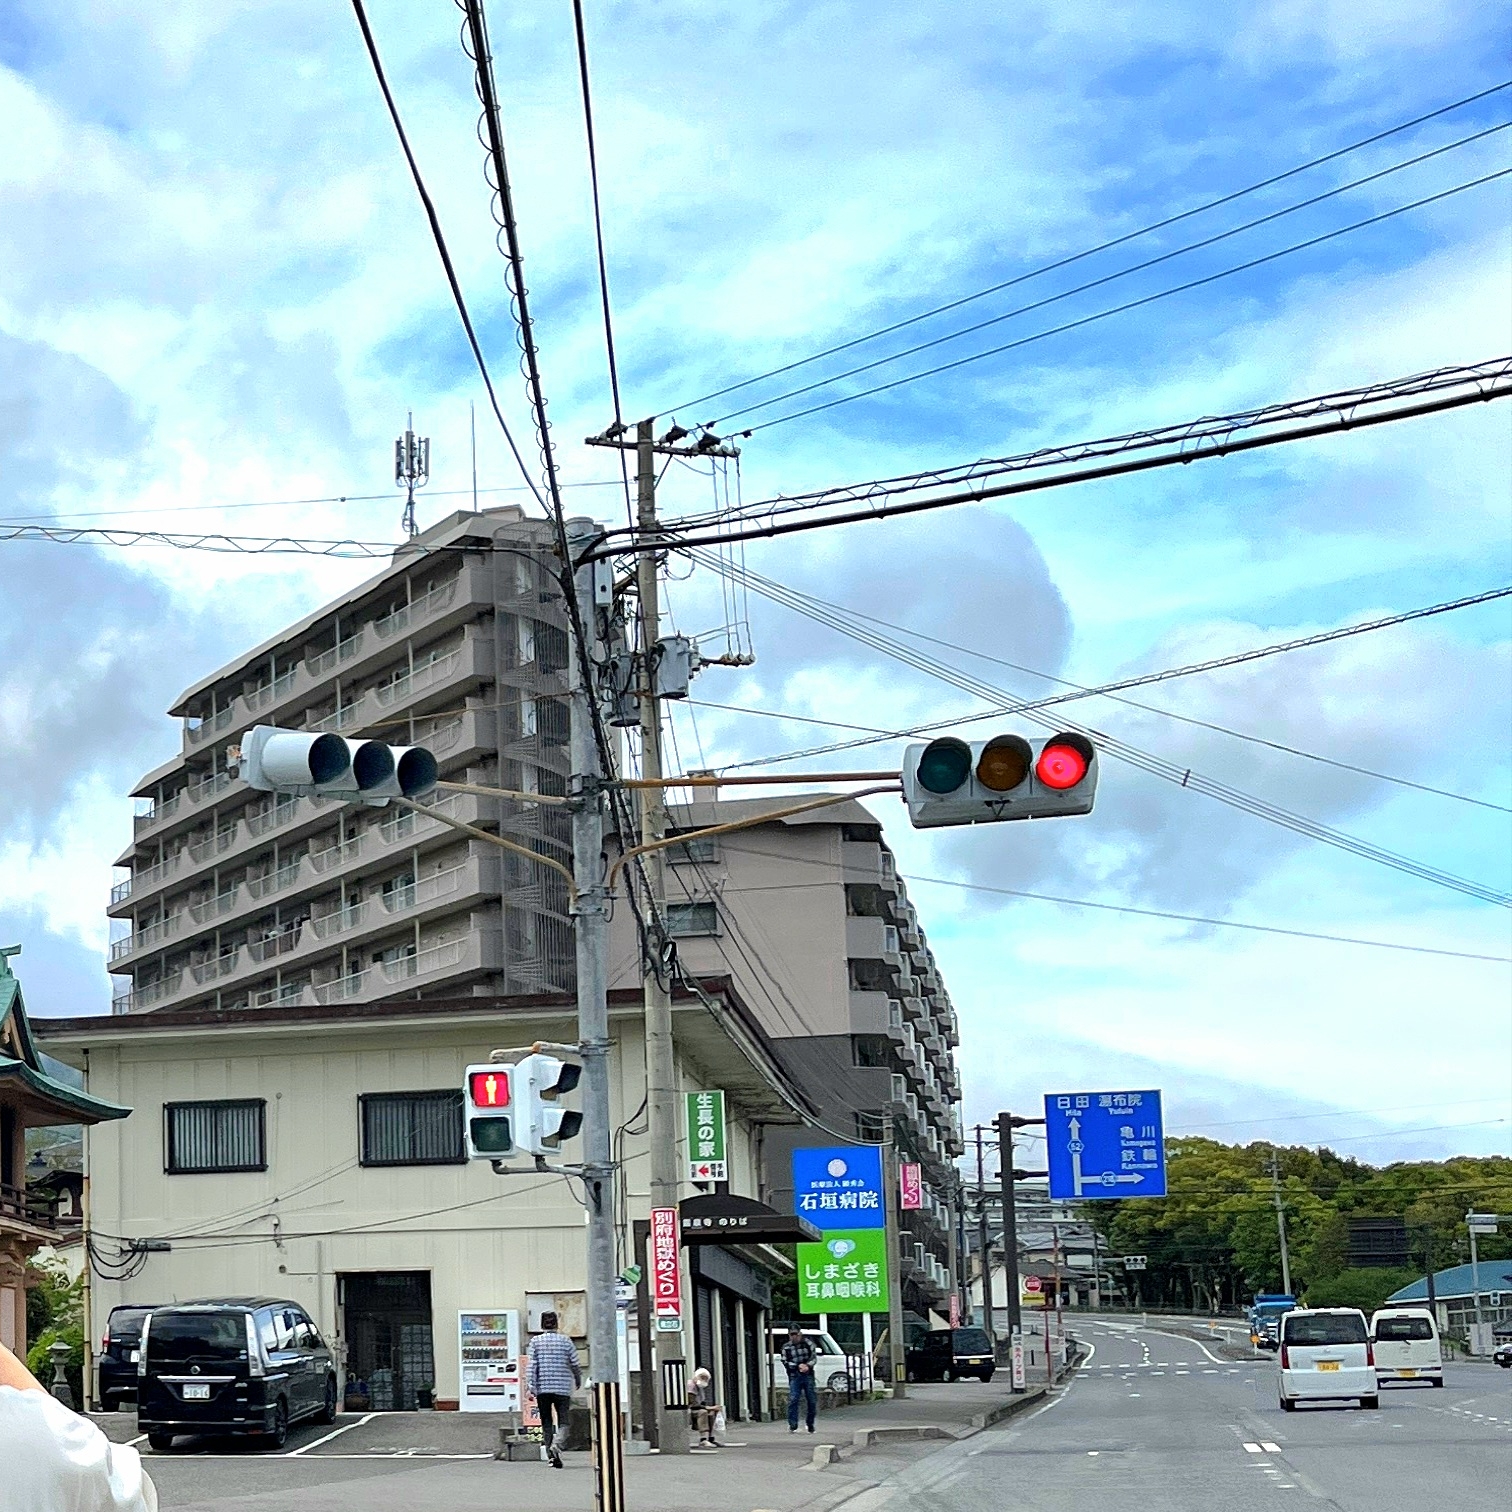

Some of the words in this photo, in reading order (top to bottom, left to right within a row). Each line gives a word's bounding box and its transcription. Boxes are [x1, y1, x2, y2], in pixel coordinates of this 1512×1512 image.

[1057, 1096, 1089, 1109] 日田
[696, 1093, 715, 1157] 生長の家
[799, 1190, 879, 1211] 石垣病院
[654, 1211, 676, 1295] 別府地獄めぐり
[805, 1262, 880, 1280] しまざき
[805, 1281, 881, 1299] 耳鼻咽喉科
